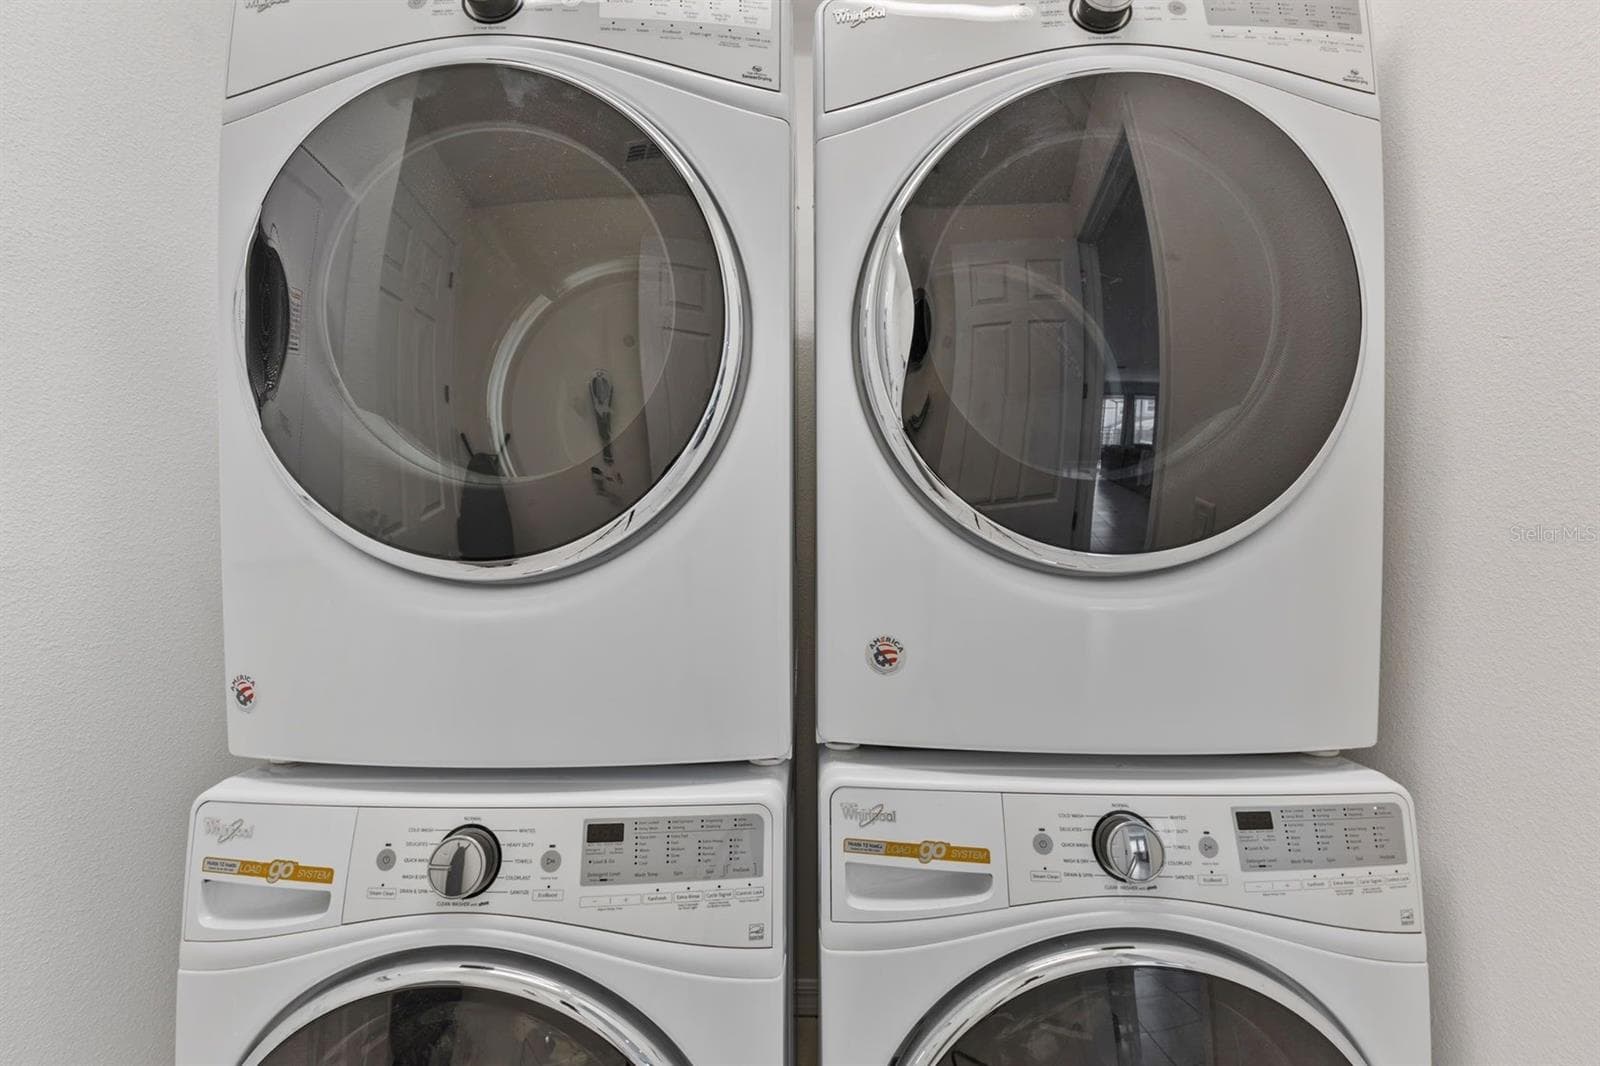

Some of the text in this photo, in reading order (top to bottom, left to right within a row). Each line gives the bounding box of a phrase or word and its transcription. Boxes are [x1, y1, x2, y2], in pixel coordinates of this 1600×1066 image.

[840, 802, 896, 828] Whirlpool
[951, 848, 987, 859] SYSTEM
[240, 862, 262, 874] LOAD
[297, 869, 331, 880] SYSTEM
